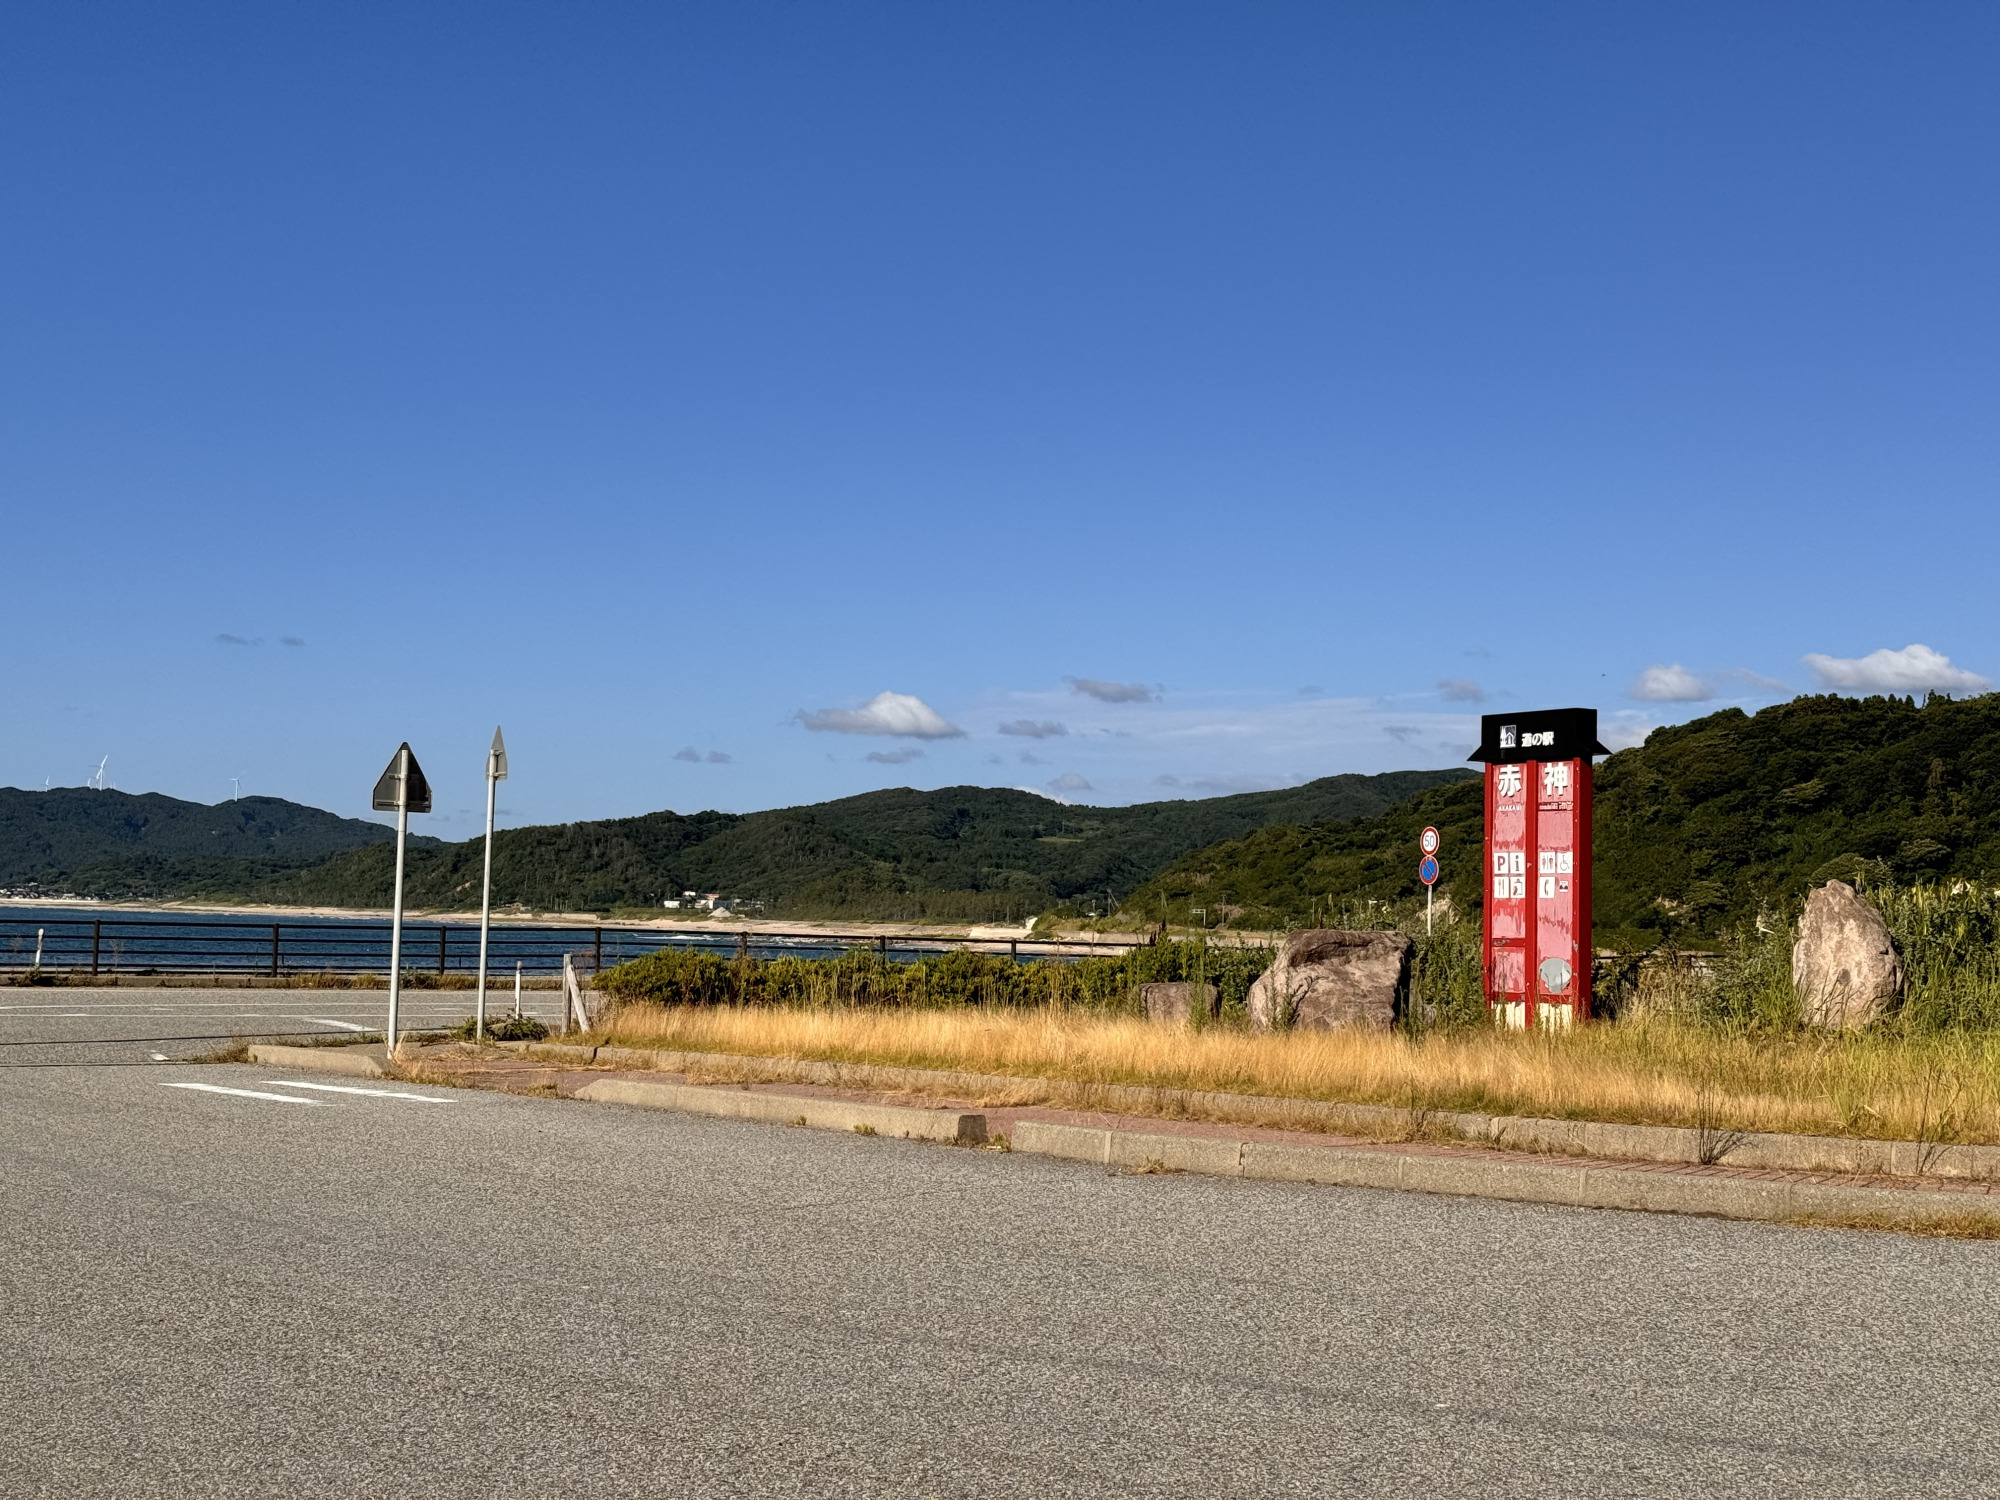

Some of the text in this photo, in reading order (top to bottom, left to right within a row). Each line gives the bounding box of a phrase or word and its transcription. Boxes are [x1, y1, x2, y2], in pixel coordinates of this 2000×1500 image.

[1521, 731, 1555, 747] 道の駅
[1424, 835, 1435, 847] 50
[1497, 856, 1506, 871] P
